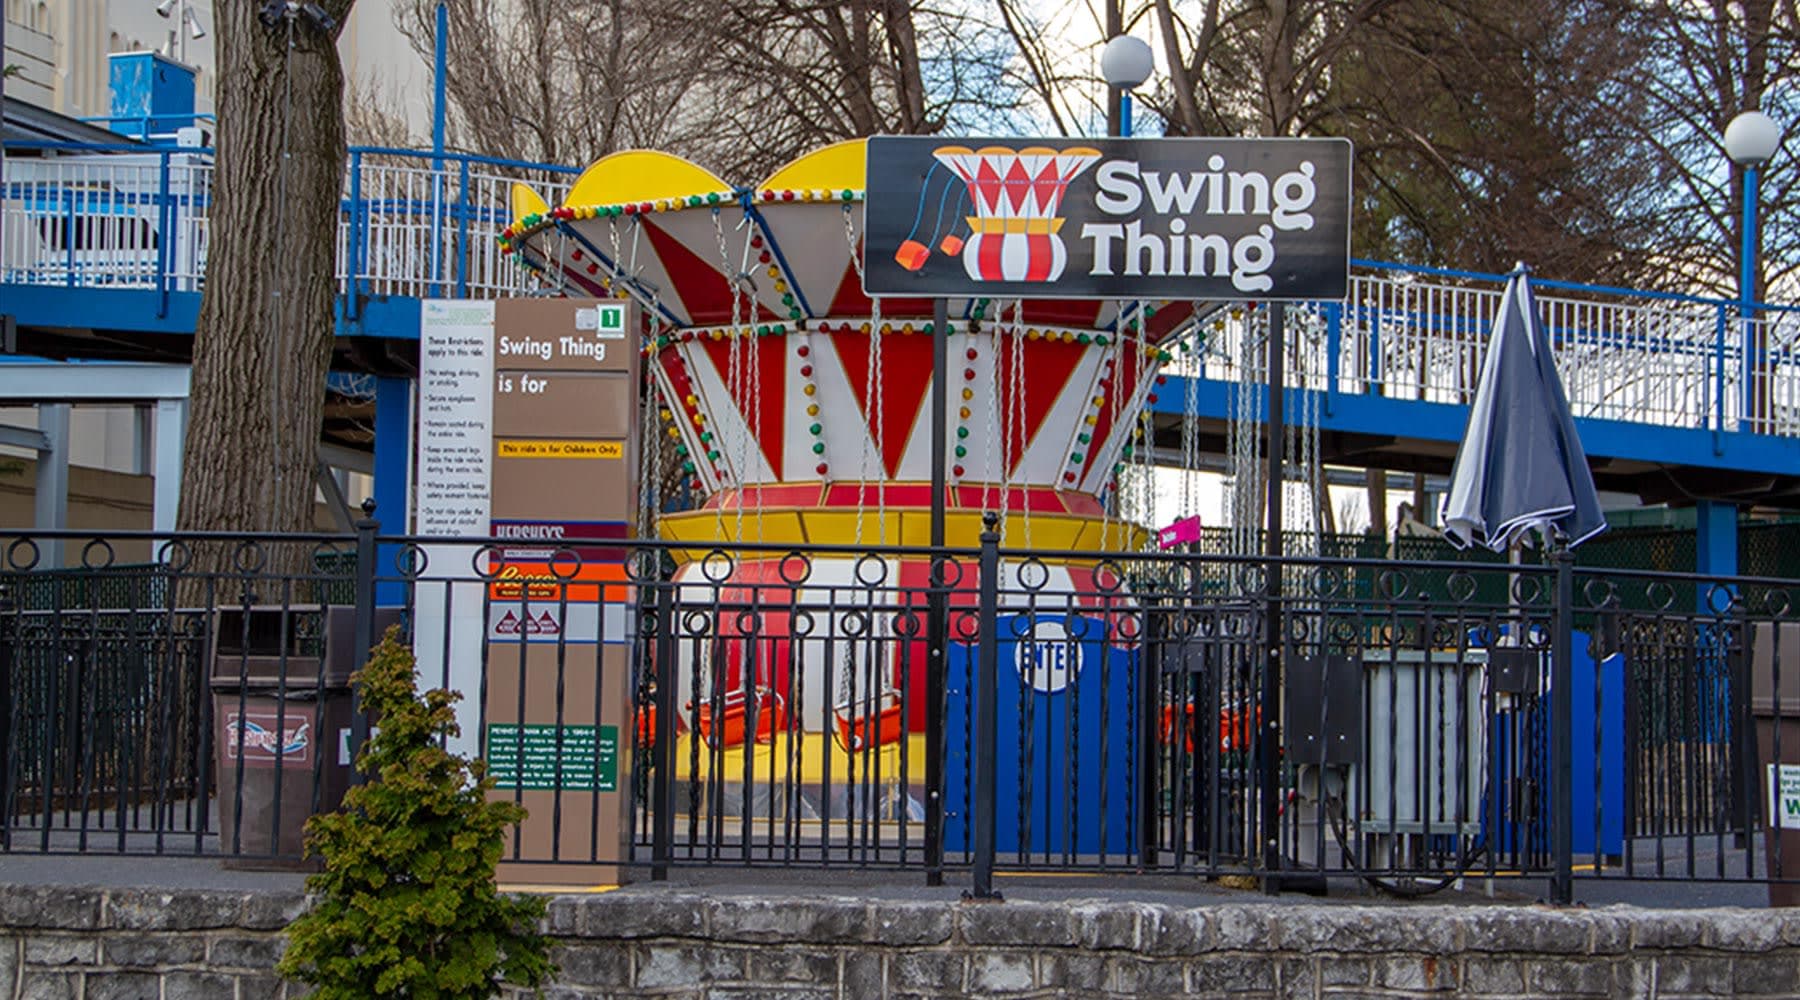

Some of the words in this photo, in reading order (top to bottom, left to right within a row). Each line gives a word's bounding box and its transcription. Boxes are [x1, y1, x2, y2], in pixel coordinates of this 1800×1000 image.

[1095, 155, 1316, 230] Swing
[1080, 217, 1275, 292] Thing
[608, 310, 613, 325] 1
[499, 336, 552, 360] Swing
[560, 336, 605, 361] Thing
[498, 374, 512, 393] is
[520, 374, 547, 394] for
[520, 445, 536, 453] ride
[548, 445, 561, 453] for
[598, 445, 618, 455] Only
